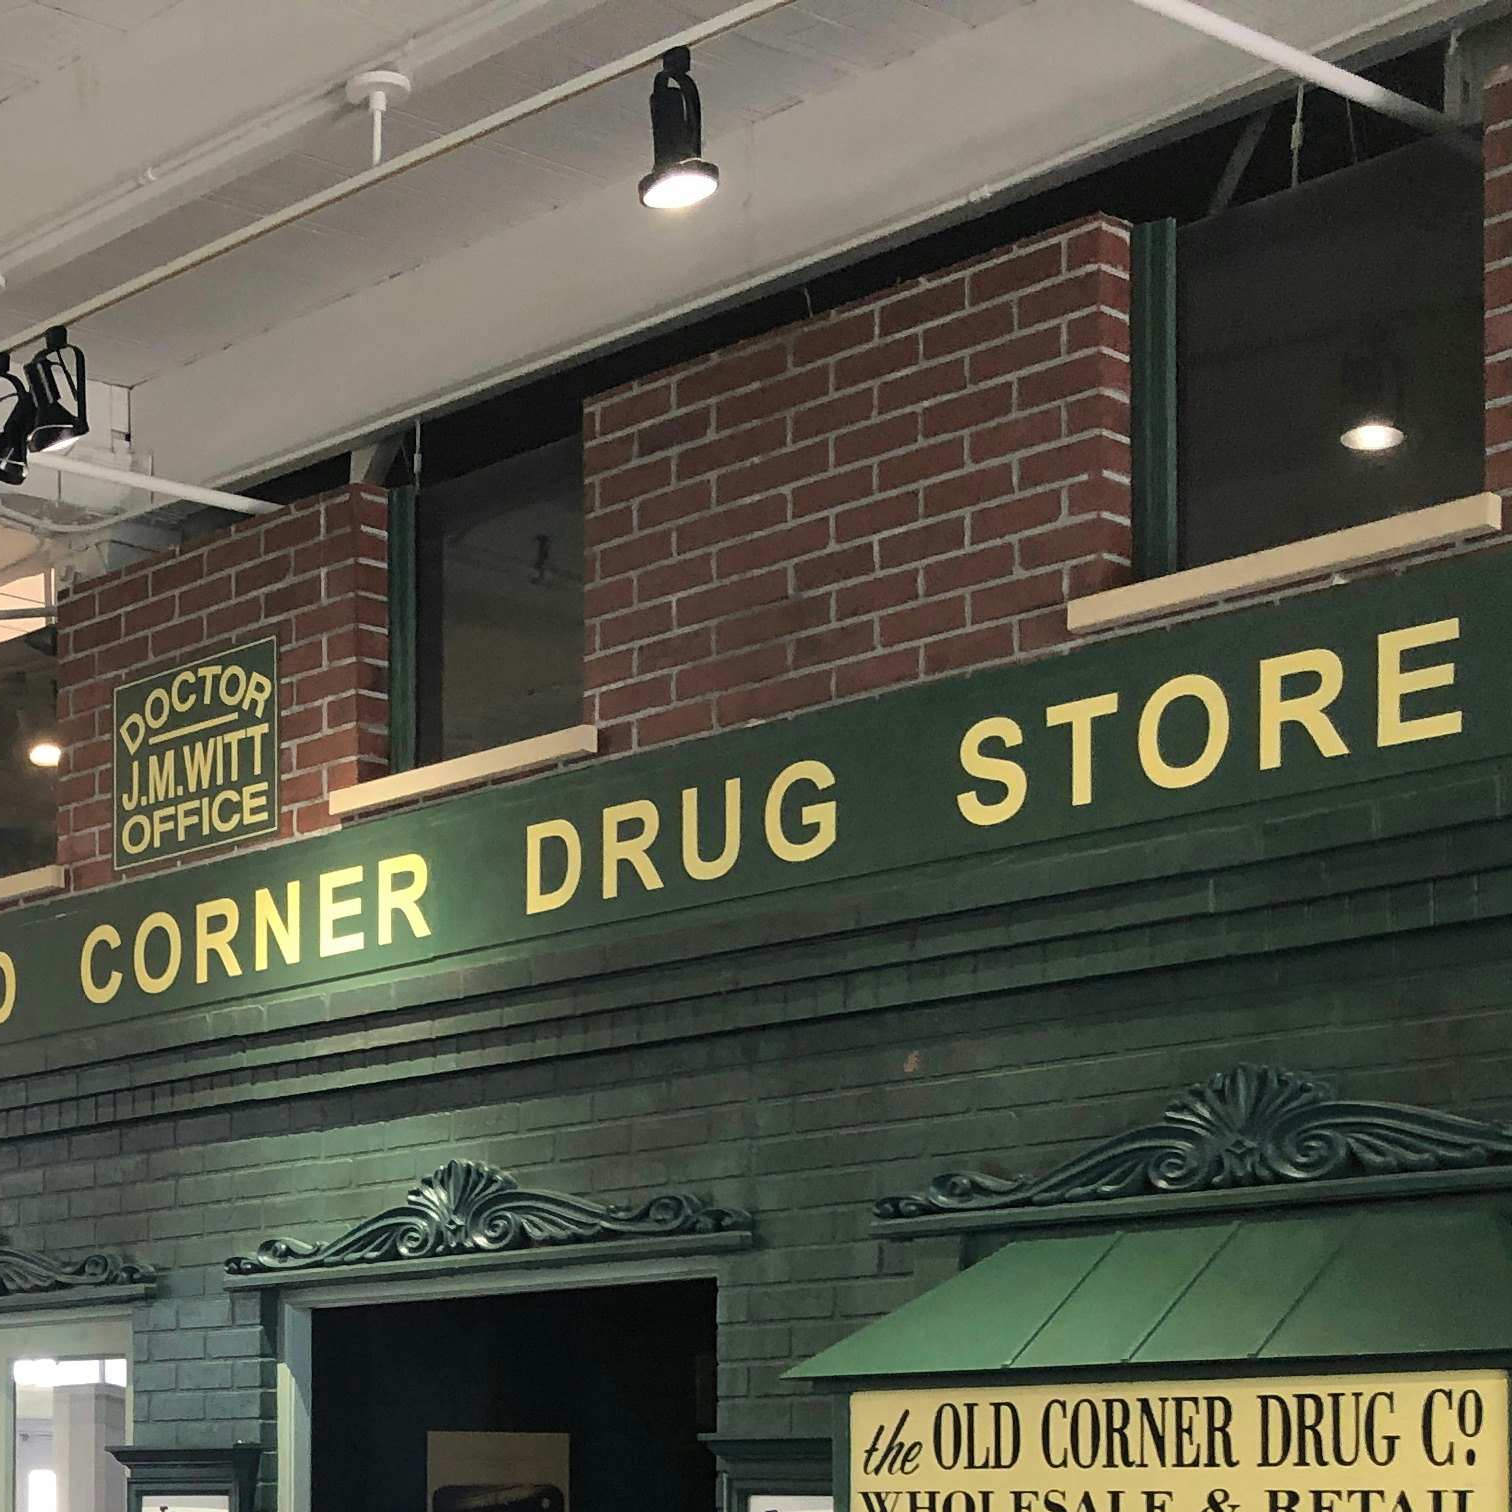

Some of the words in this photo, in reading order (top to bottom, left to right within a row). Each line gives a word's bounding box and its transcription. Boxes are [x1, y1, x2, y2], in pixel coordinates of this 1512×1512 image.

[119, 665, 272, 755] DOCTOR
[80, 852, 432, 1005] CORNER
[525, 758, 838, 916] DRUG
[956, 616, 1464, 827] STORE
[122, 782, 269, 854] OFFICE
[862, 1409, 923, 1476] the
[933, 1402, 1021, 1470] OLD
[1041, 1395, 1240, 1469] CORNER
[1256, 1391, 1401, 1468] DRUG
